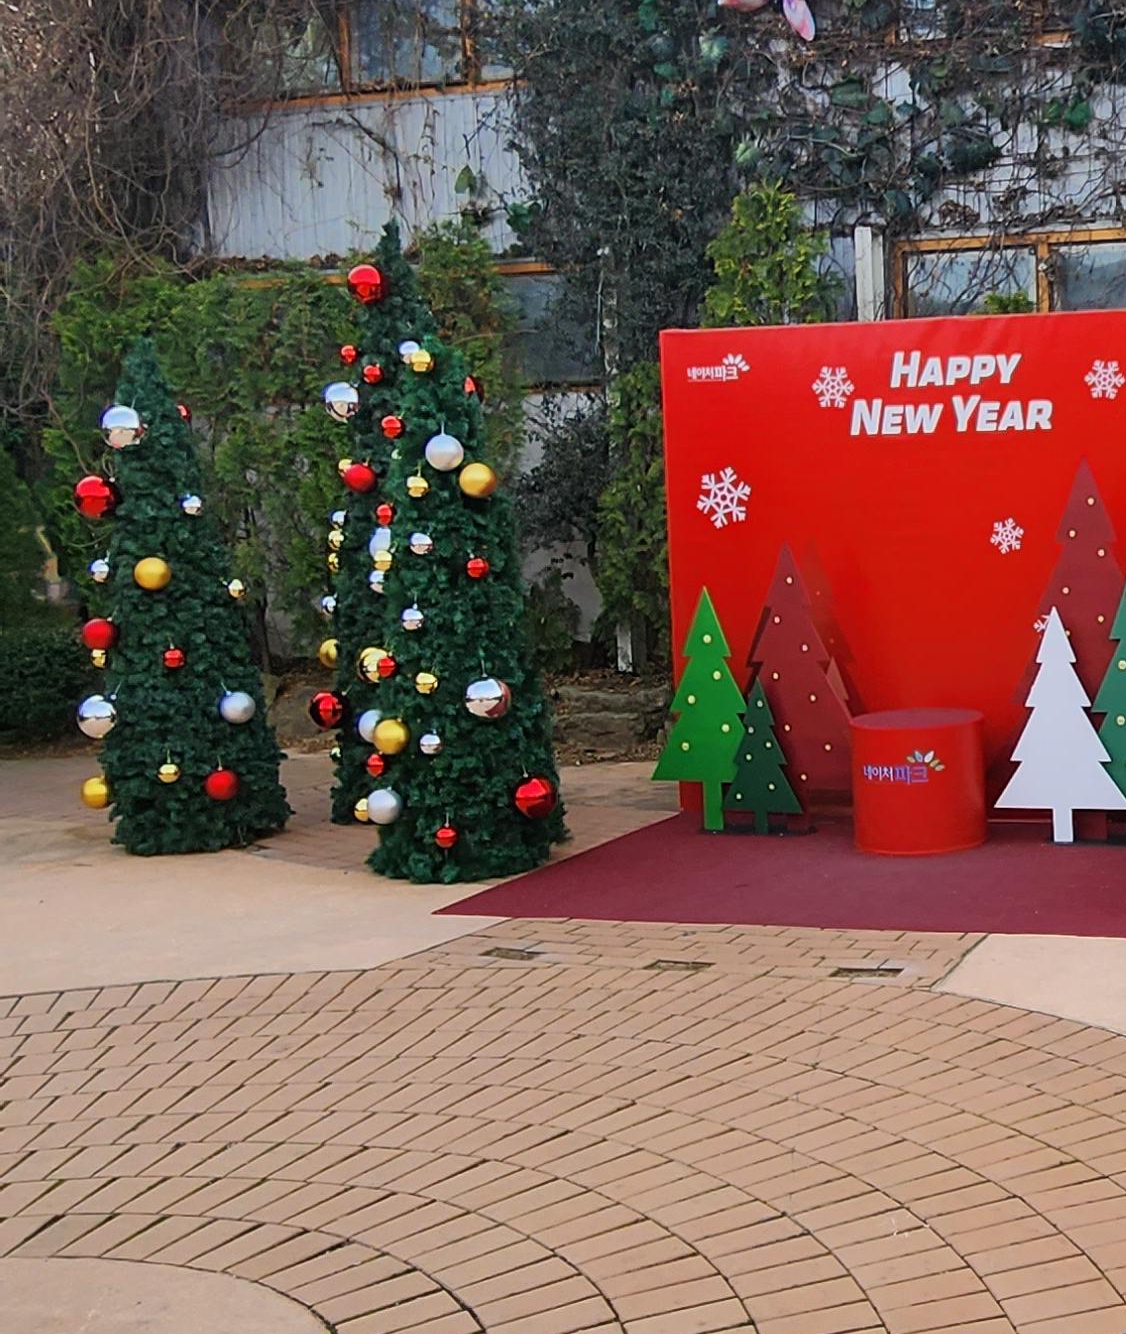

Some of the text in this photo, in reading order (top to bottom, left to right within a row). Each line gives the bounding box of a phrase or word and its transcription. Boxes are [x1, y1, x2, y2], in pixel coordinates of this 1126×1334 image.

[686, 364, 739, 382] 네이처파크
[890, 350, 1022, 388] HAPPY
[850, 394, 1053, 436] NEW YEAR
[863, 764, 929, 785] 네이처파크
